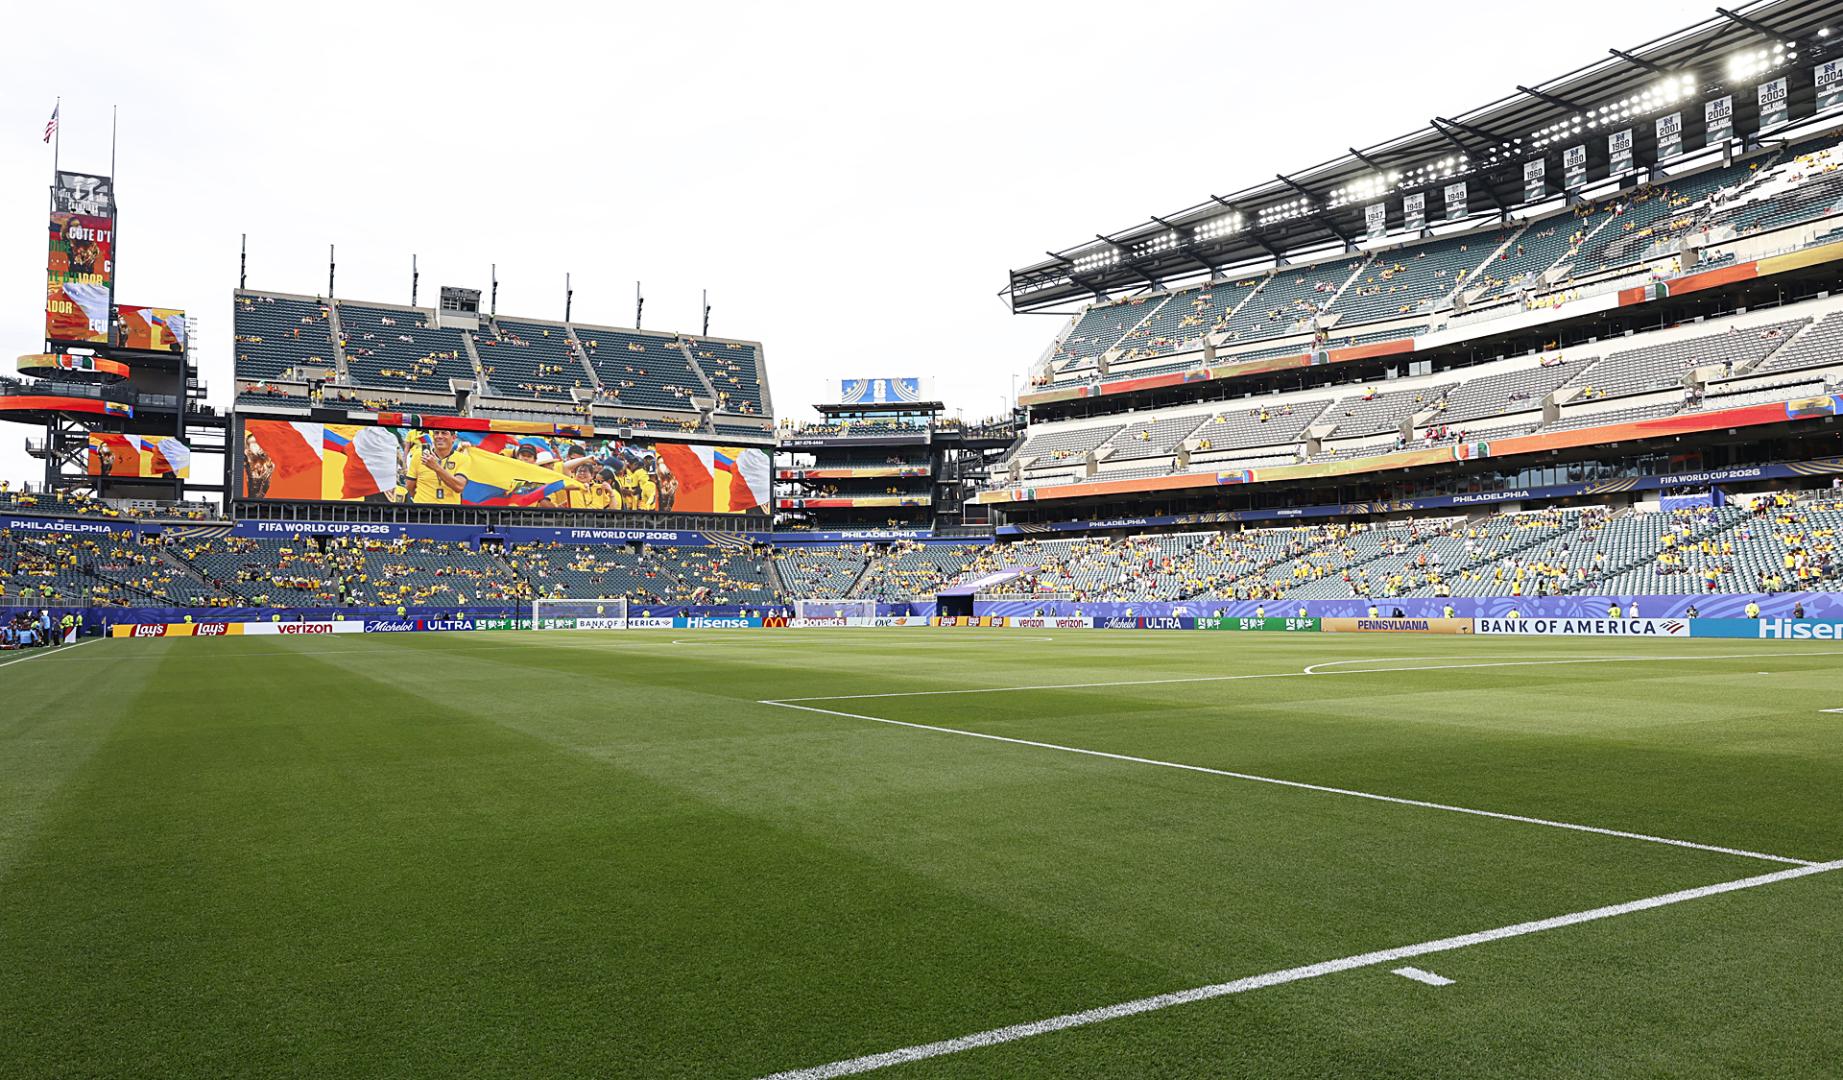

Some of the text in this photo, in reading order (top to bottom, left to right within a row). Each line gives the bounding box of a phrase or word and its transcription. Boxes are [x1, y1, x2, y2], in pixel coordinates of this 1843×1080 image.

[1817, 69, 1843, 85] 2004
[1761, 88, 1785, 103] 2003
[1708, 106, 1730, 120] 2002
[1660, 122, 1679, 136] 2001
[1612, 139, 1629, 152] 1988
[1566, 154, 1584, 167] 1980
[1527, 168, 1543, 179] 1960
[1447, 191, 1465, 201] 1949
[1368, 212, 1383, 220] 1947
[1660, 468, 1760, 485] FIFA WORLD CUP 2026
[1453, 490, 1529, 503] PHILADELPHIA
[11, 521, 112, 532] PHILADELPHIA
[258, 523, 283, 531] FIFA
[284, 523, 327, 532] WORLD
[328, 524, 349, 533] CUP
[351, 525, 389, 534] 2026
[1089, 518, 1146, 528] PHILADELPHIA
[571, 530, 591, 538] FIFA
[592, 531, 626, 539] WORLD
[646, 532, 677, 540] 2026
[278, 621, 332, 633] verizon
[365, 620, 472, 632] Michelob ULTRA
[687, 617, 749, 628] Hisense
[1019, 617, 1044, 627] verizon
[1056, 617, 1083, 628] verizon
[1104, 617, 1181, 629] Michelob ULTRA
[1358, 620, 1429, 630] PENNSYLVANIA
[1481, 620, 1656, 635] BANK OF AMERICA
[135, 624, 164, 637] Lay's
[197, 623, 225, 636] Lay's
